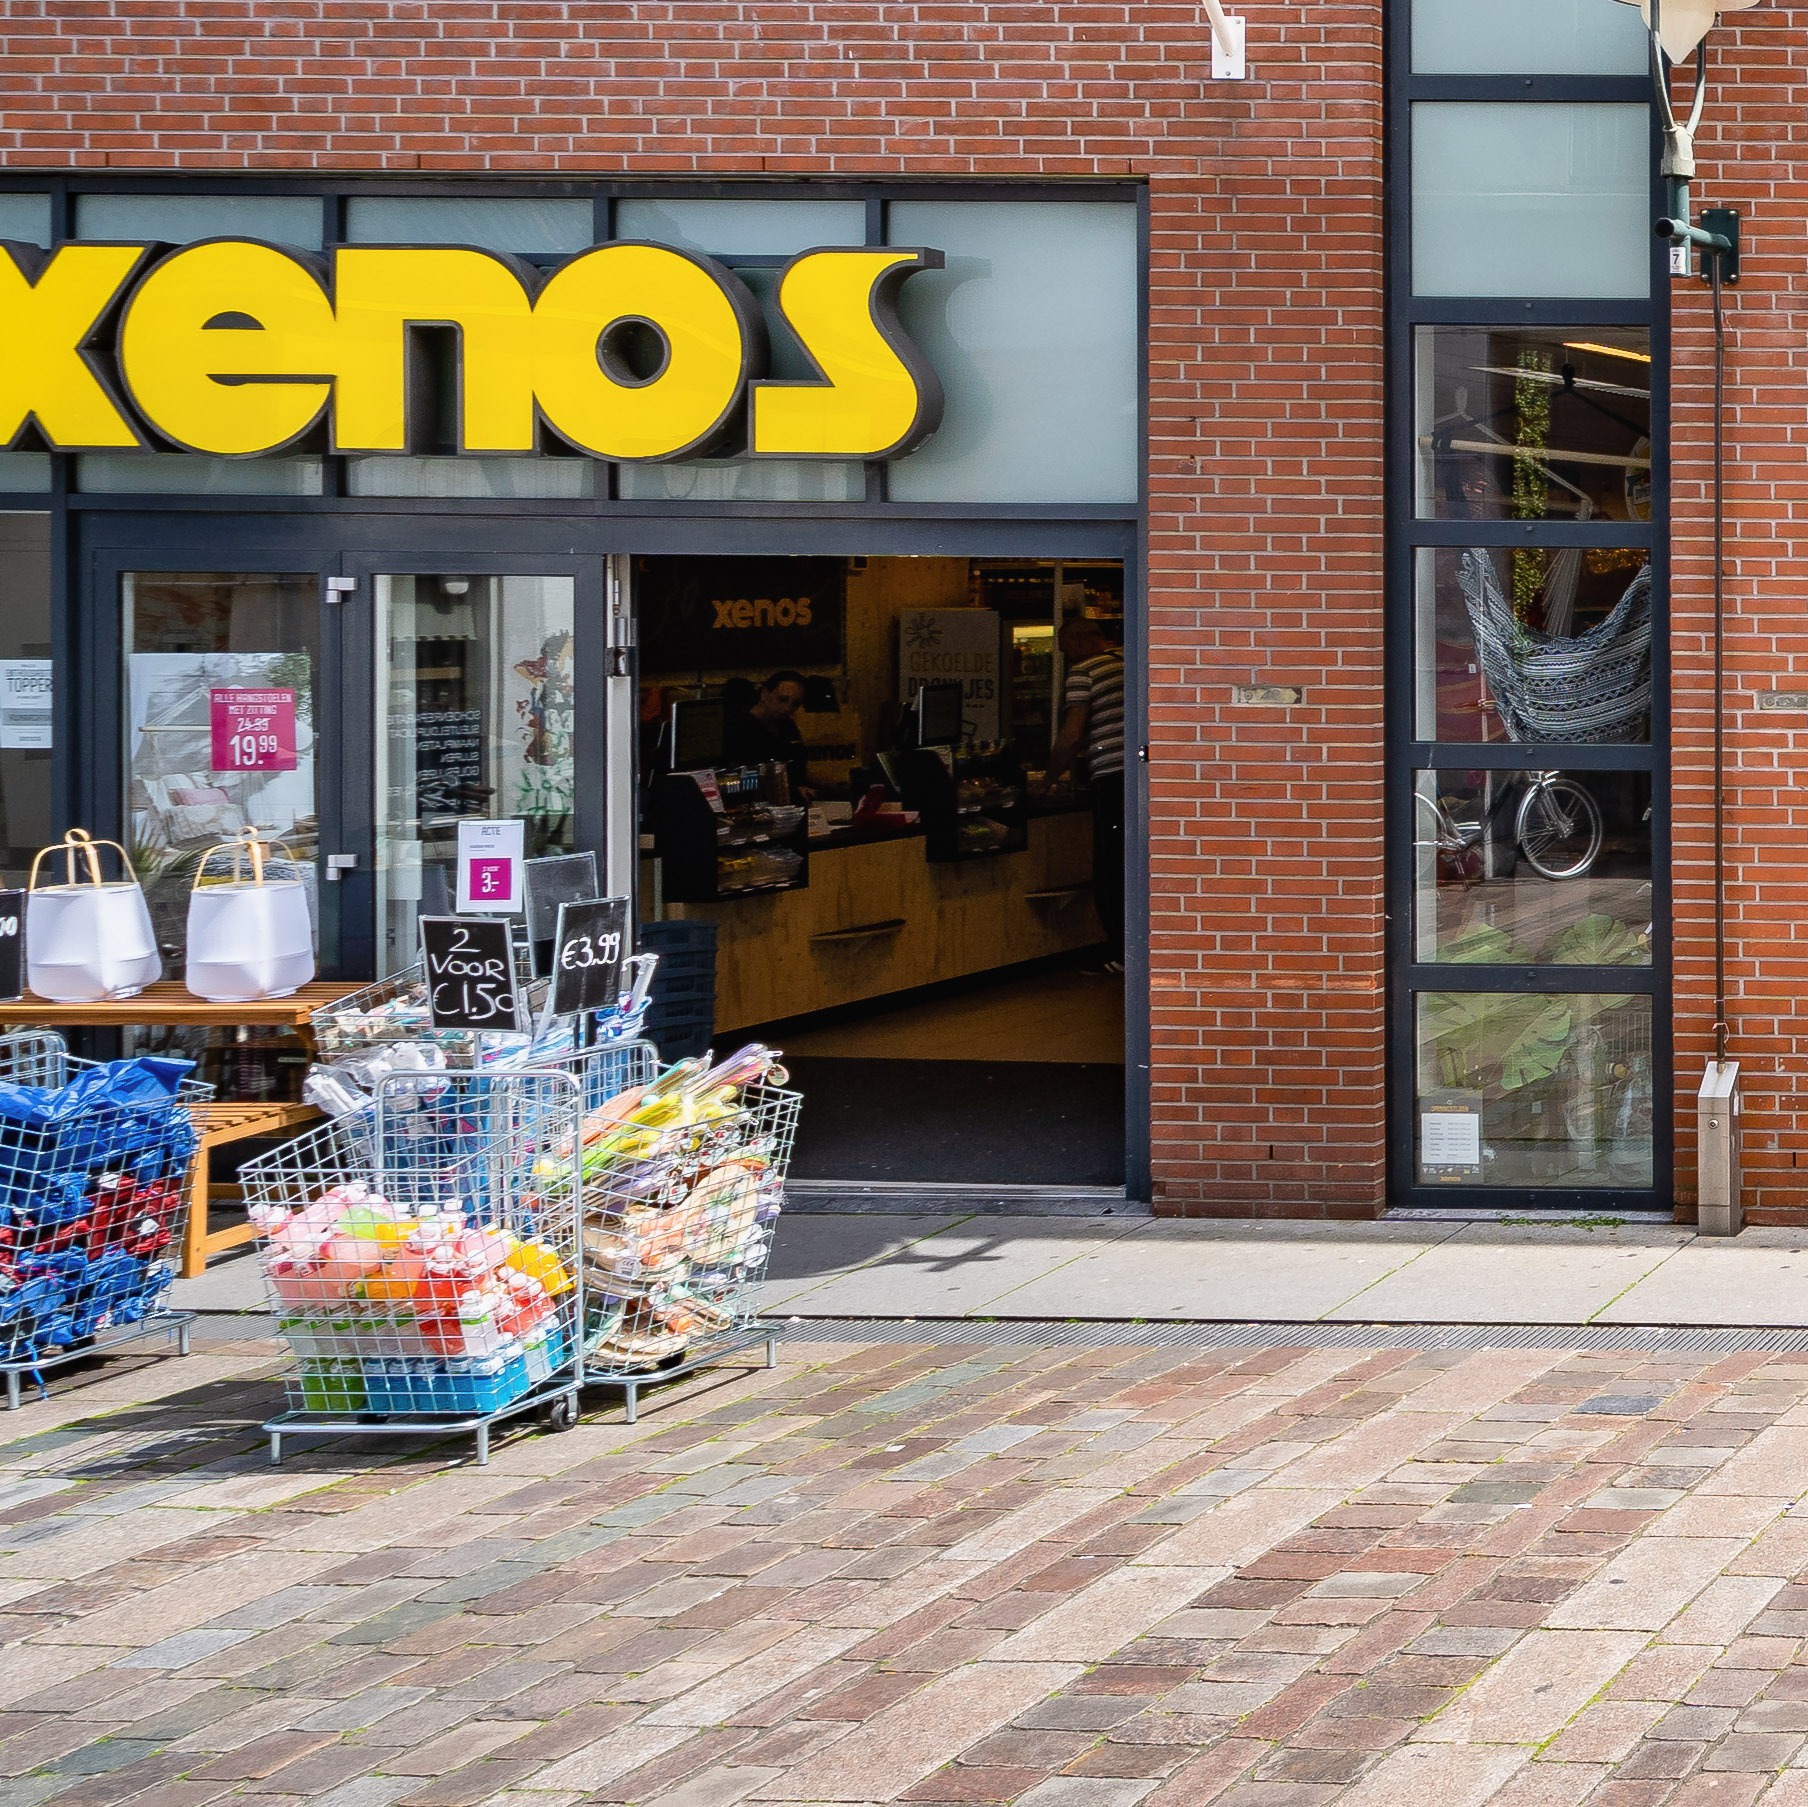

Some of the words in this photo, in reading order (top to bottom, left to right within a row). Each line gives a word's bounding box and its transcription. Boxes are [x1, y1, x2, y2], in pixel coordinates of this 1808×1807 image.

[0, 236, 942, 462] xenos
[712, 597, 813, 629] xenos
[448, 928, 481, 953] 2
[430, 953, 506, 981] VOOR
